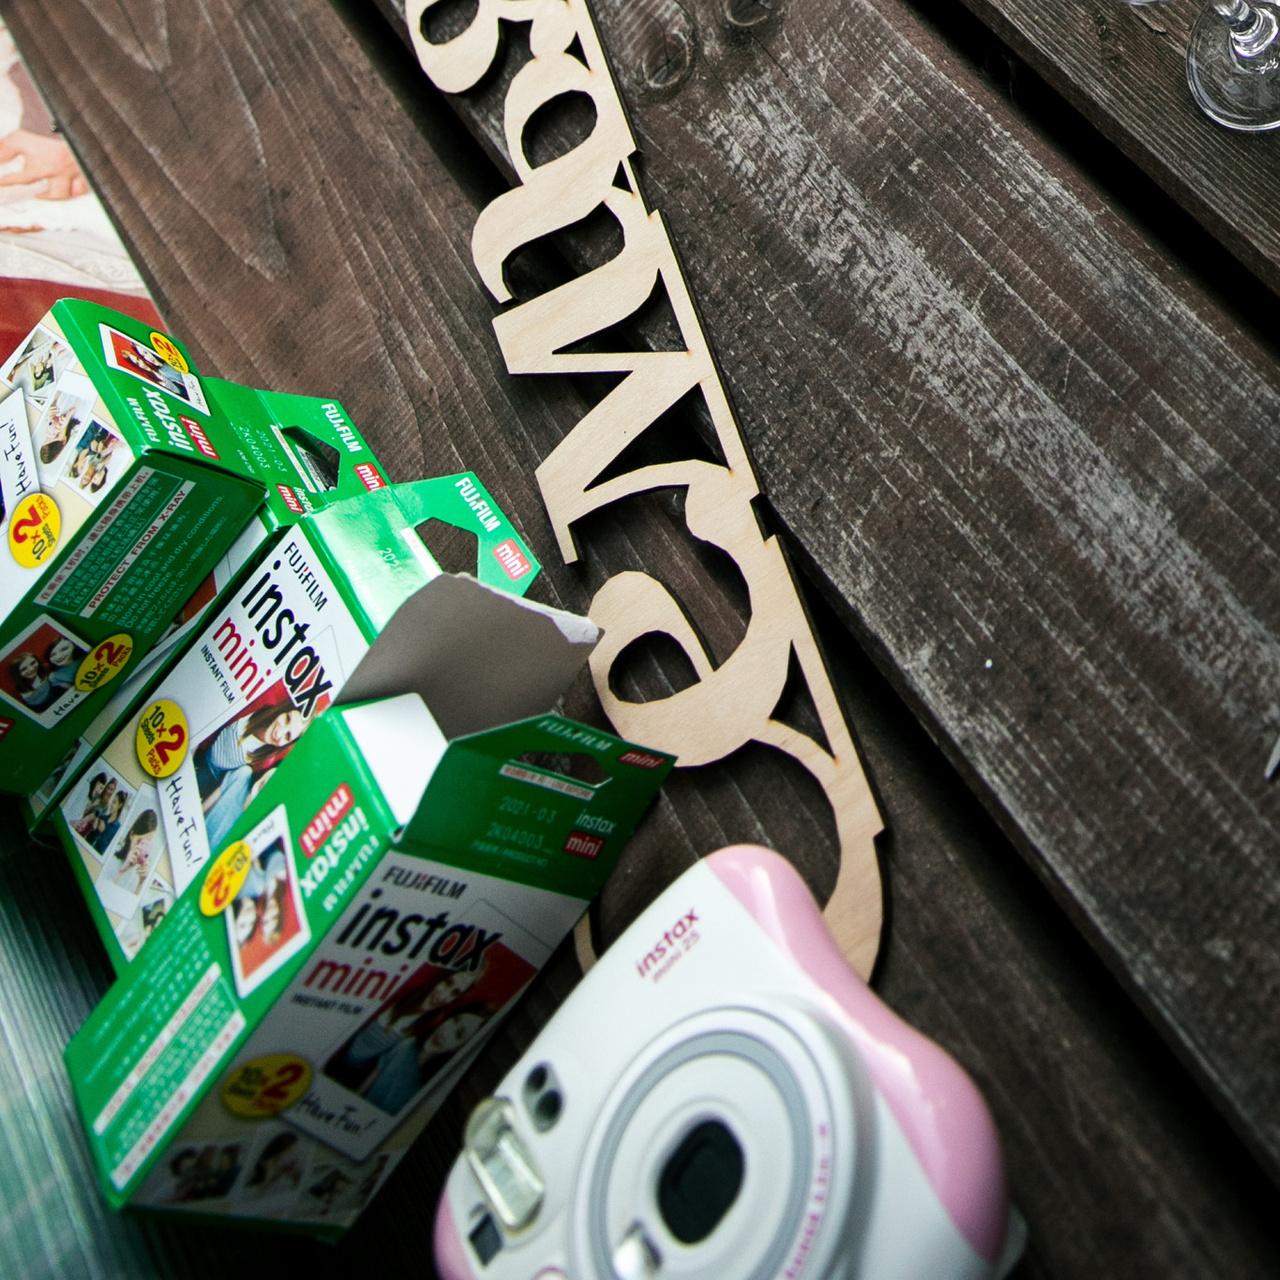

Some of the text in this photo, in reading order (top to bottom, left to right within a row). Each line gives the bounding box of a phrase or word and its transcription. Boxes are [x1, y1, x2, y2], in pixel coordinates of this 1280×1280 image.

[126, 397, 161, 443] FUJIFILM
[142, 386, 194, 453] instax
[180, 416, 217, 458] mini
[321, 403, 363, 453] FUJIFILM
[15, 452, 32, 497] Have
[356, 464, 382, 491] min
[278, 486, 303, 512] mini
[293, 486, 315, 513] insta
[455, 476, 501, 532] FUJIFILM
[89, 490, 186, 609] PROTECT FROM X-RAY
[161, 555, 176, 572] and
[174, 539, 188, 554] dry
[496, 543, 529, 577] mini
[283, 541, 329, 612] FUJIFILM
[124, 615, 138, 628] Do
[240, 559, 334, 719] instax
[200, 644, 236, 705] INSTANT FILM
[212, 616, 272, 702] mini
[536, 719, 614, 752] FUJIFILM
[146, 748, 162, 776] Packs
[619, 751, 664, 769] mini
[165, 776, 203, 868] Have Fun!
[301, 787, 349, 853] mini
[575, 809, 618, 835] instax
[299, 805, 370, 898] instax
[566, 836, 603, 857] mini
[383, 865, 468, 900] FUJIFILM
[335, 888, 503, 972] instax
[636, 907, 700, 978] instax
[304, 957, 409, 1002] mini
